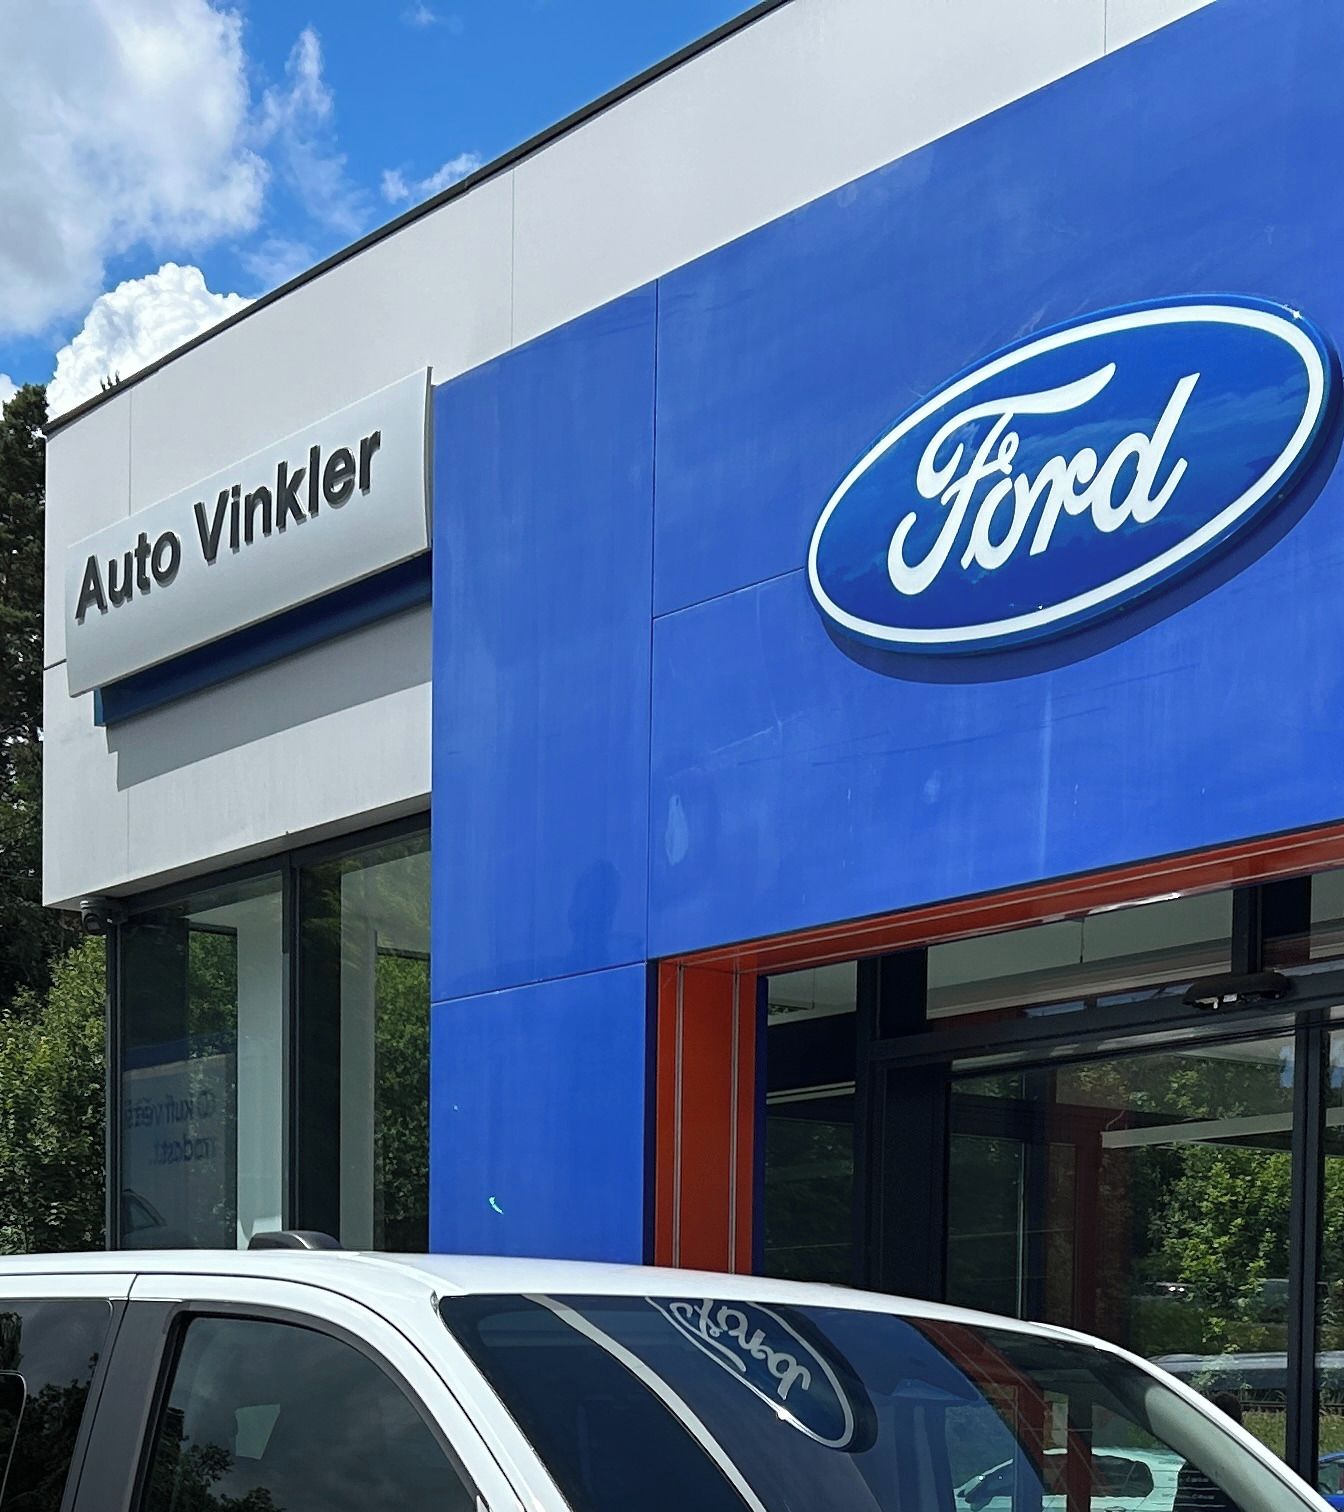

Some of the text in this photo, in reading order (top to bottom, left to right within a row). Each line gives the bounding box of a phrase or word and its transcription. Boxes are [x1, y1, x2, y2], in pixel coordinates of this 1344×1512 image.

[75, 430, 381, 624] Auto Vinkler
[887, 362, 1201, 596] Ford
